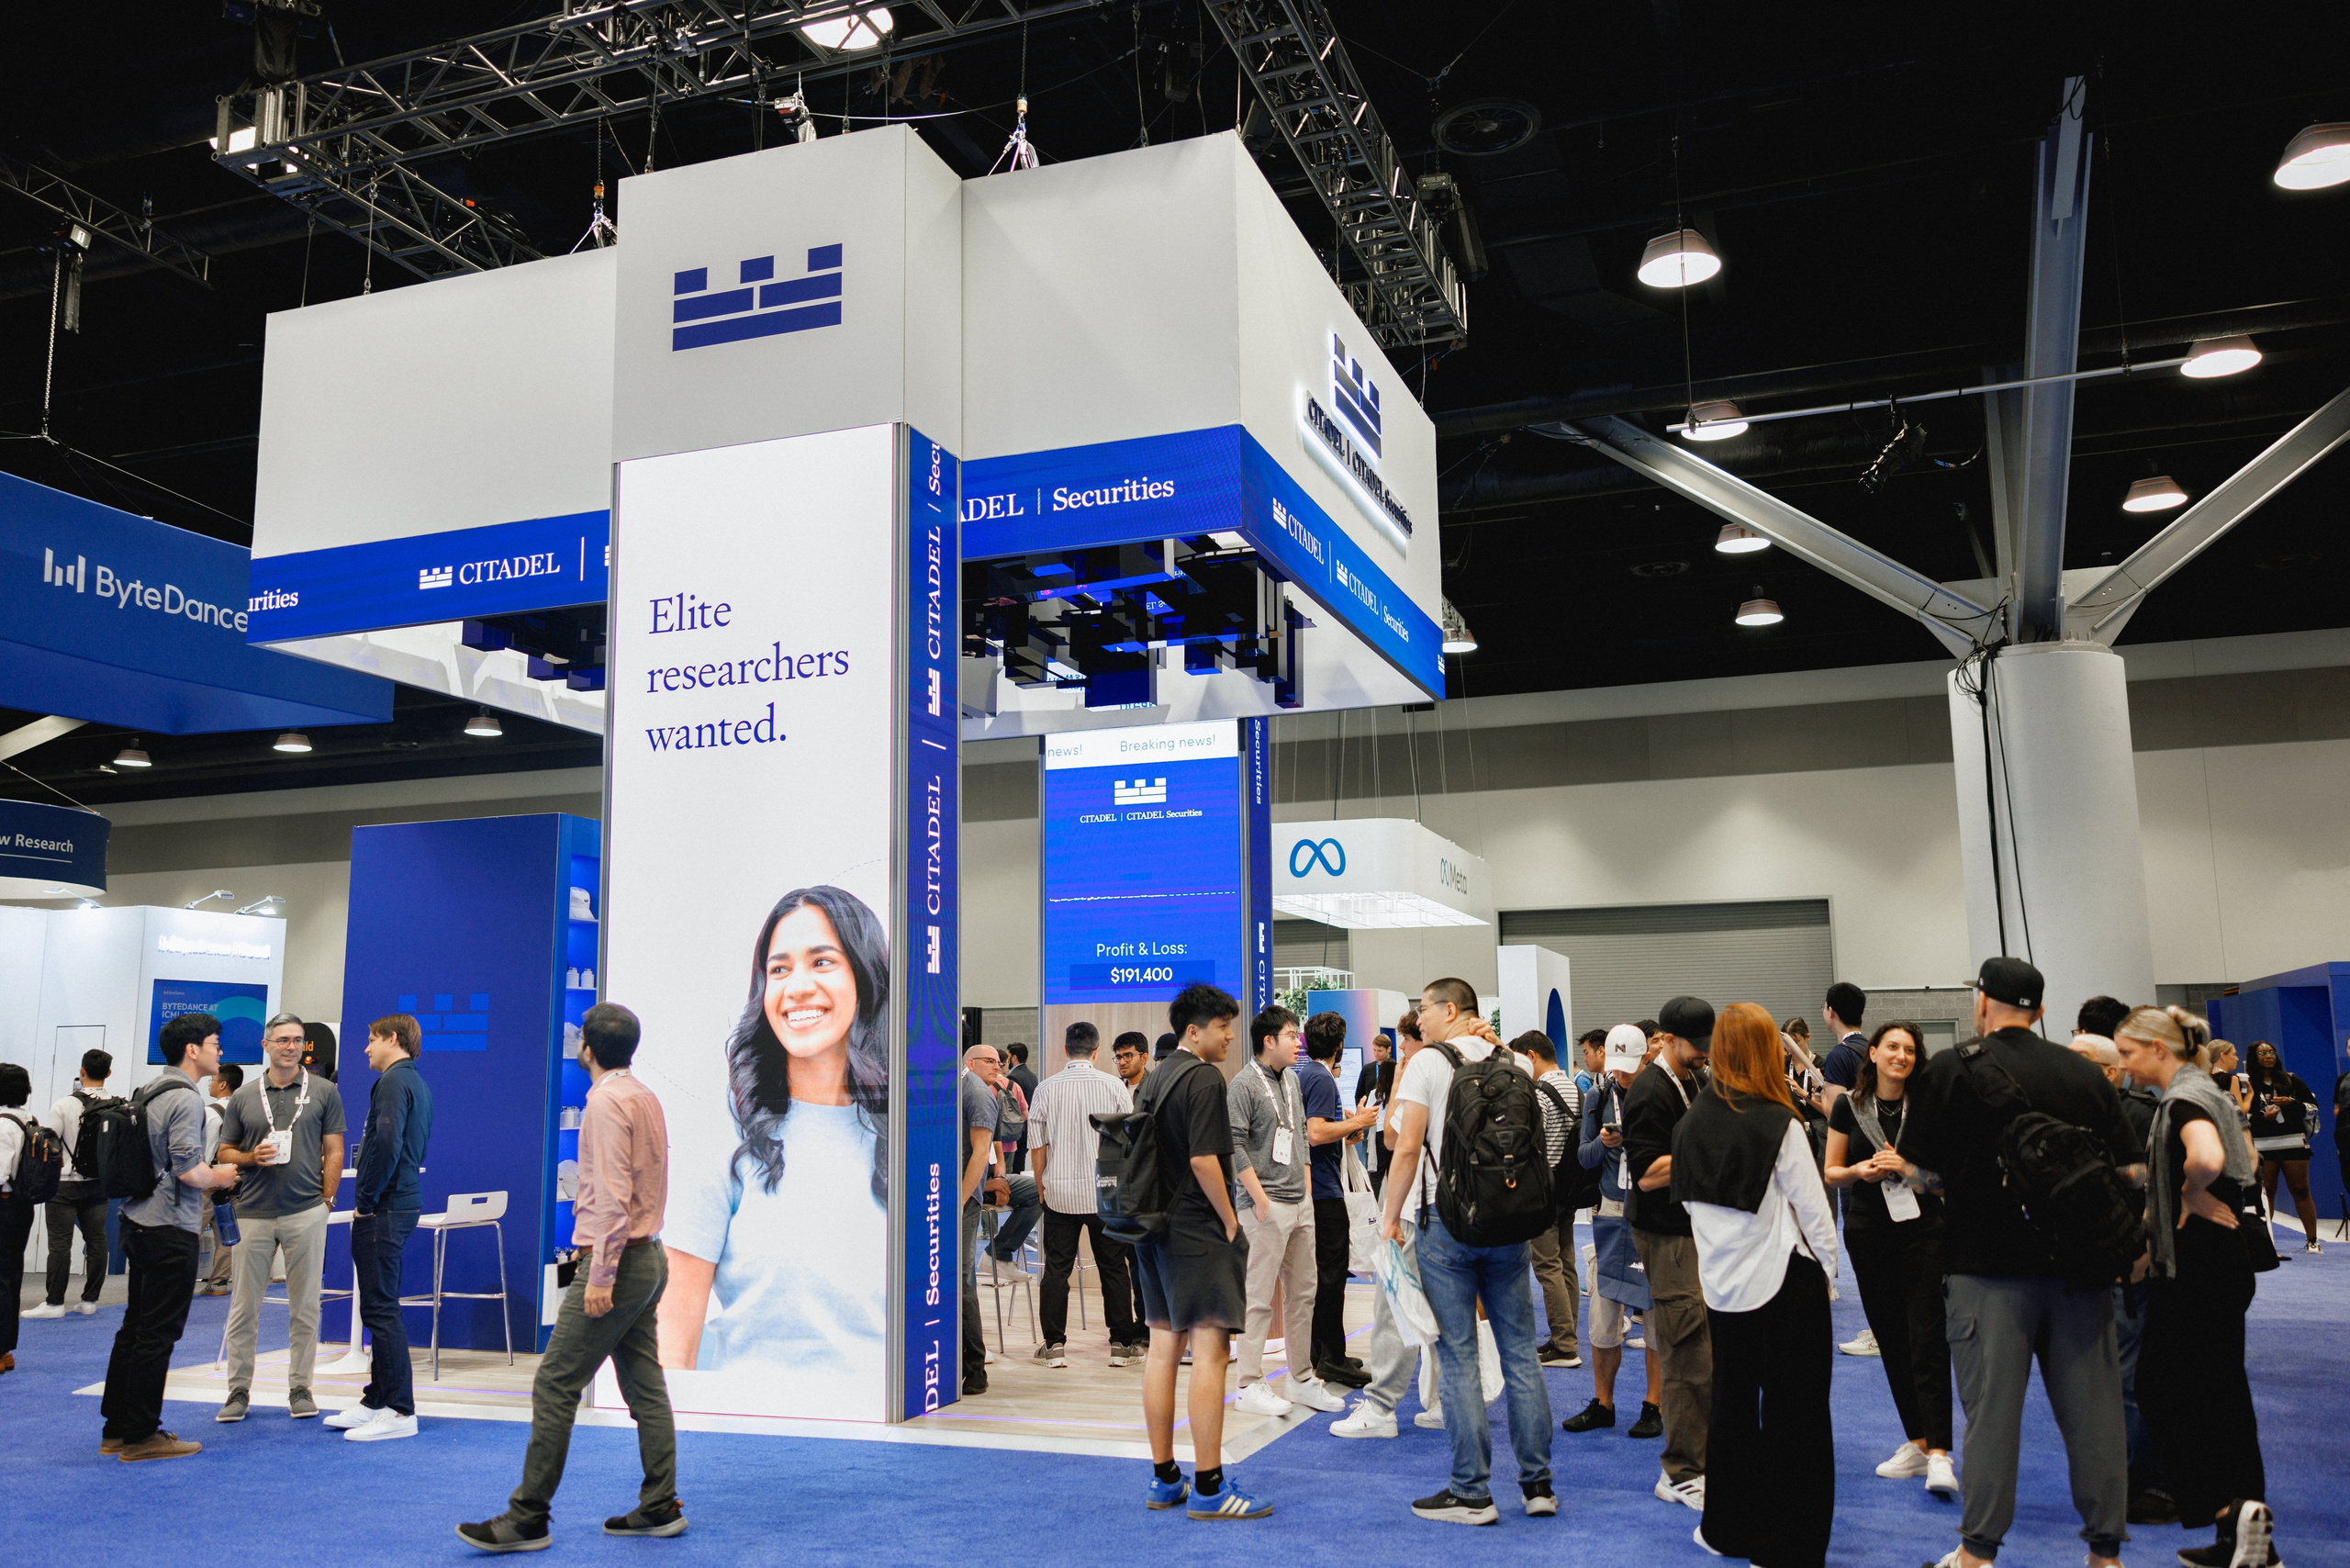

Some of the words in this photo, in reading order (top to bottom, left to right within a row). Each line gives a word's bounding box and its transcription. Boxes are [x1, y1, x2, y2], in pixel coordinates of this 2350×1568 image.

[1308, 397, 1346, 456] CITADEL
[1352, 450, 1384, 504] CITADEL
[1053, 476, 1174, 511] Securities
[1288, 513, 1324, 566] CITADEL
[459, 553, 561, 585] CITADEL
[928, 525, 941, 660] CITADEL
[96, 565, 248, 633] ByteDance
[648, 591, 732, 634] Elite
[1348, 572, 1378, 616] CITADEL
[1383, 605, 1409, 643] Securities
[646, 641, 849, 693] researchers
[645, 701, 787, 752] wanted.
[1047, 744, 1083, 757] news!
[1120, 738, 1175, 753] Breaking
[1180, 734, 1215, 747] news!
[1254, 719, 1262, 805] Securities
[1080, 813, 1117, 823] CITADEL
[1126, 811, 1164, 821] CITADEL
[1166, 809, 1203, 819] Securities
[15, 833, 73, 853] Research
[927, 775, 940, 915] CITADEL
[1449, 862, 1467, 895] Meta
[1096, 943, 1135, 958] Profit
[1138, 942, 1148, 956] &
[1152, 941, 1188, 956] Loss:
[1110, 967, 1173, 984] $191,400
[162, 1002, 207, 1012] BYTEDANCE
[208, 1003, 219, 1013] AT
[926, 1162, 940, 1305] Securities
